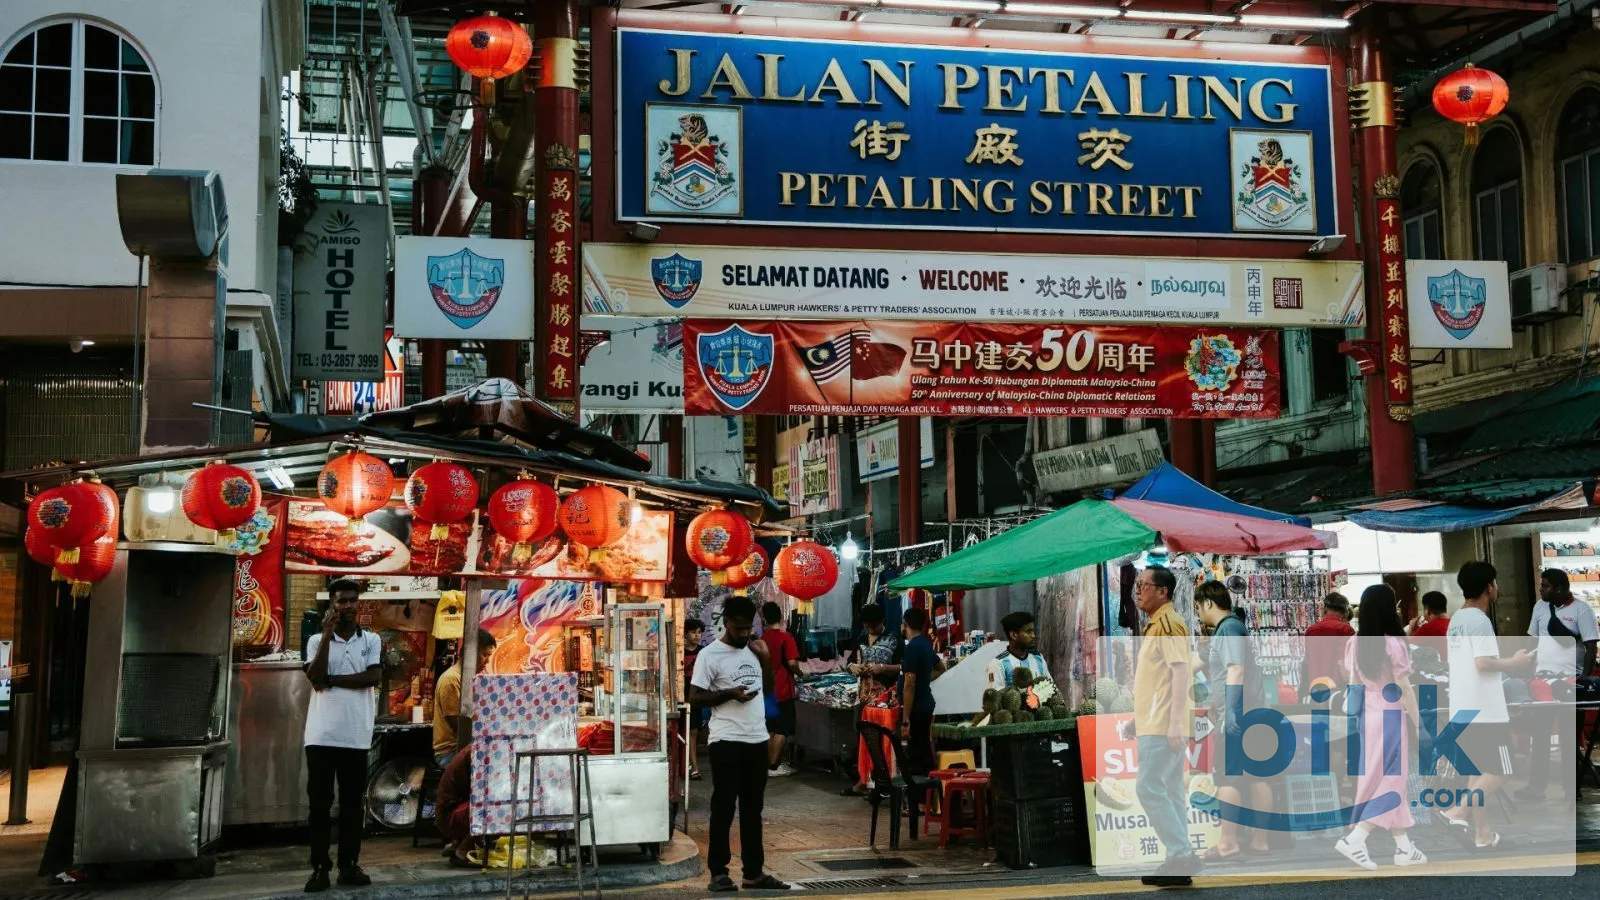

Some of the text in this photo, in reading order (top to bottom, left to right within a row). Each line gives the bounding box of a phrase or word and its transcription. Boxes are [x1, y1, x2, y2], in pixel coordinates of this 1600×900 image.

[658, 48, 1299, 123] JALAN PETALING
[778, 171, 1016, 214] PETALING
[1030, 180, 1202, 218] STREET
[320, 236, 360, 245] AMIGO
[722, 264, 1008, 291] SELAMAT DATANG WELCOME
[1035, 275, 1128, 300] 欢迎光临
[1245, 268, 1263, 317] 丙申年
[325, 249, 354, 350] HOTEL
[728, 303, 757, 311] KUALA
[759, 304, 795, 312] LUMPUR
[852, 305, 878, 313] PETTY
[922, 306, 977, 315] ASSOCIATION
[1079, 309, 1109, 317] PERSATUAN
[321, 353, 355, 368] 03-2857
[358, 354, 378, 368] 3999
[648, 382, 684, 397] Ku
[912, 376, 1155, 390] Ulang Tahun Ke-50 Hubungan Diplomatik Malaysia-China
[328, 381, 352, 411] BUKA
[354, 381, 375, 412] 24
[377, 376, 402, 411] JAM
[912, 389, 1156, 403] 50th Anniversary of Malaysia-China Diplomatic Relations
[789, 404, 831, 412] PERSATUAN
[832, 405, 861, 413] PENJAJA
[1077, 407, 1097, 415] PETTY
[1130, 407, 1174, 416] ASSOCIATION
[1095, 805, 1222, 831] Musa ing
